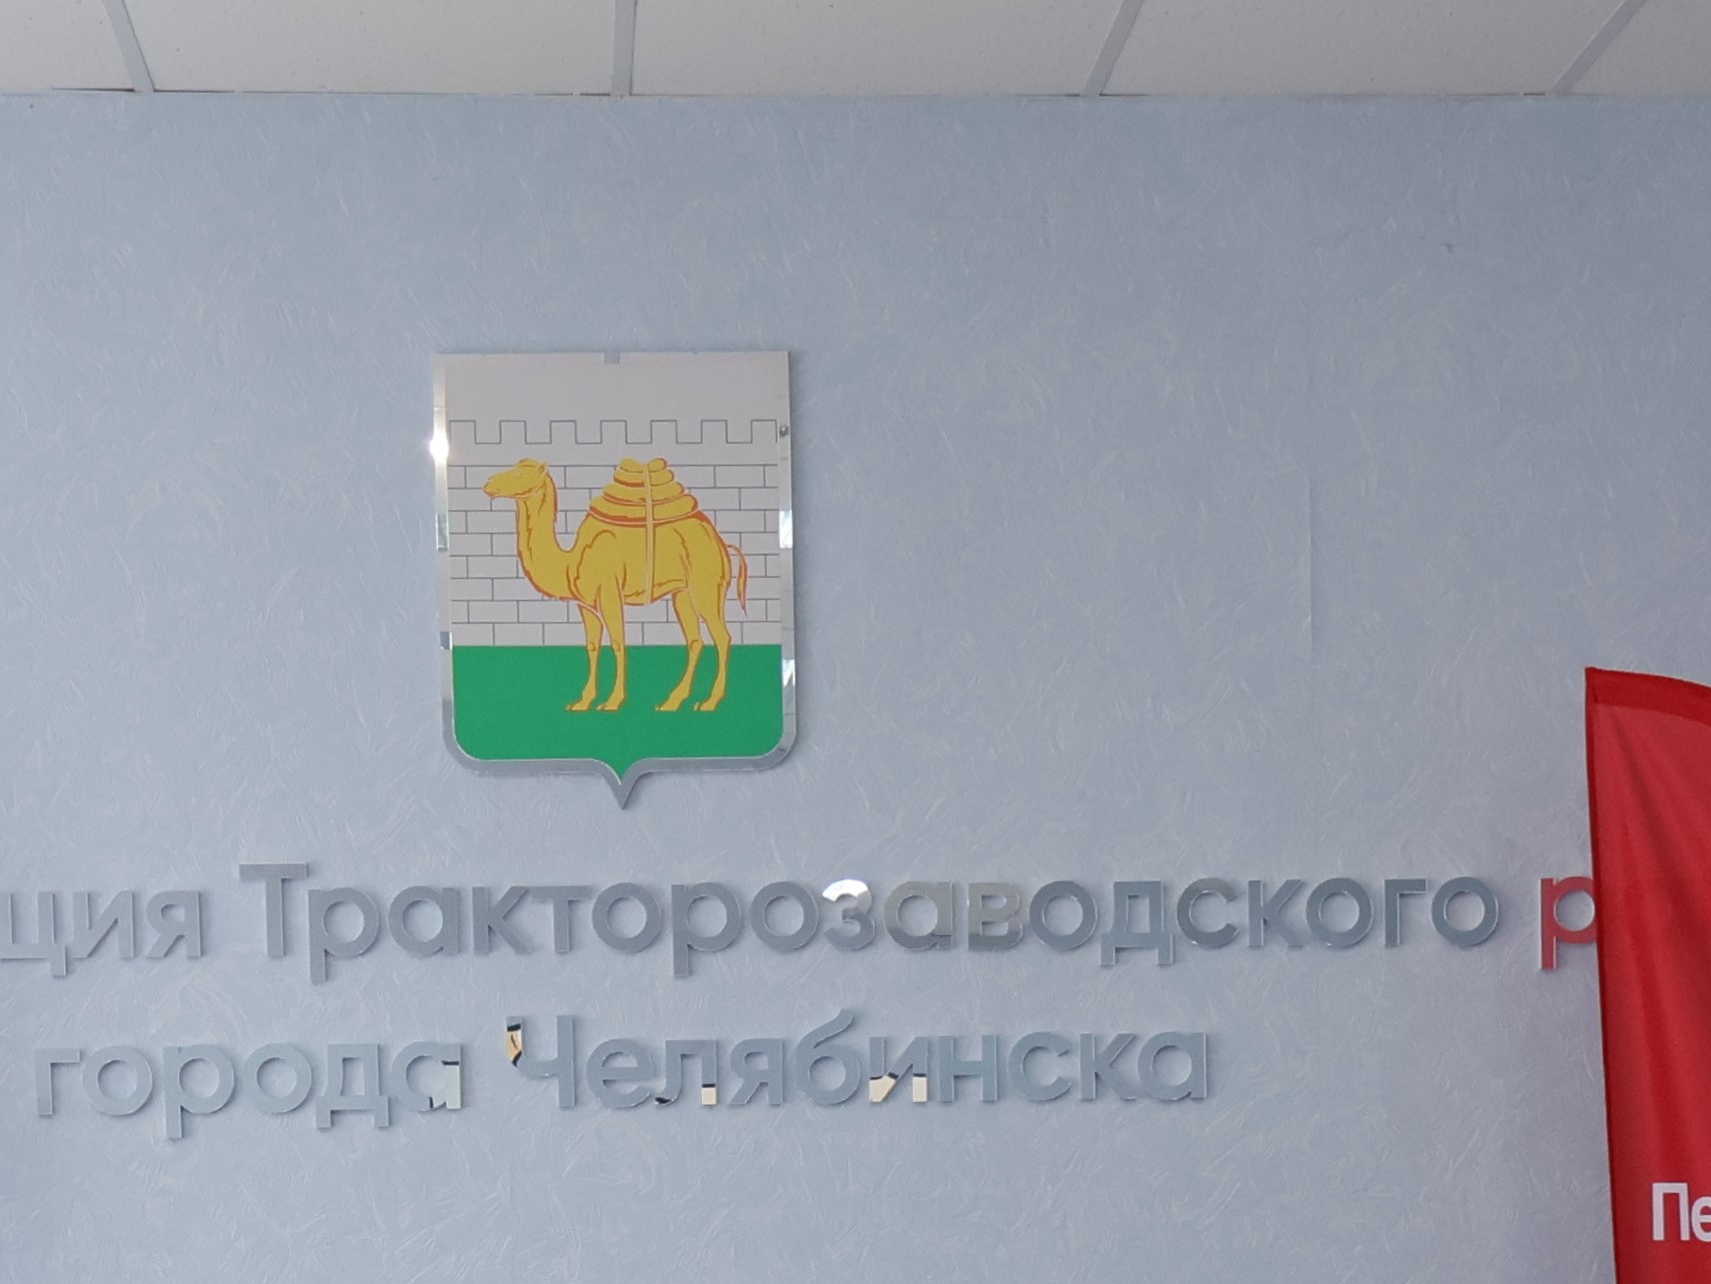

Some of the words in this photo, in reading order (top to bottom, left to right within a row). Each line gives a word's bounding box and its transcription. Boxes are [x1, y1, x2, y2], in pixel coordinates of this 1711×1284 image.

[238, 862, 1500, 984] Тракторозаводского
[34, 1039, 463, 1139] города
[504, 1007, 1209, 1109] Челябинска
